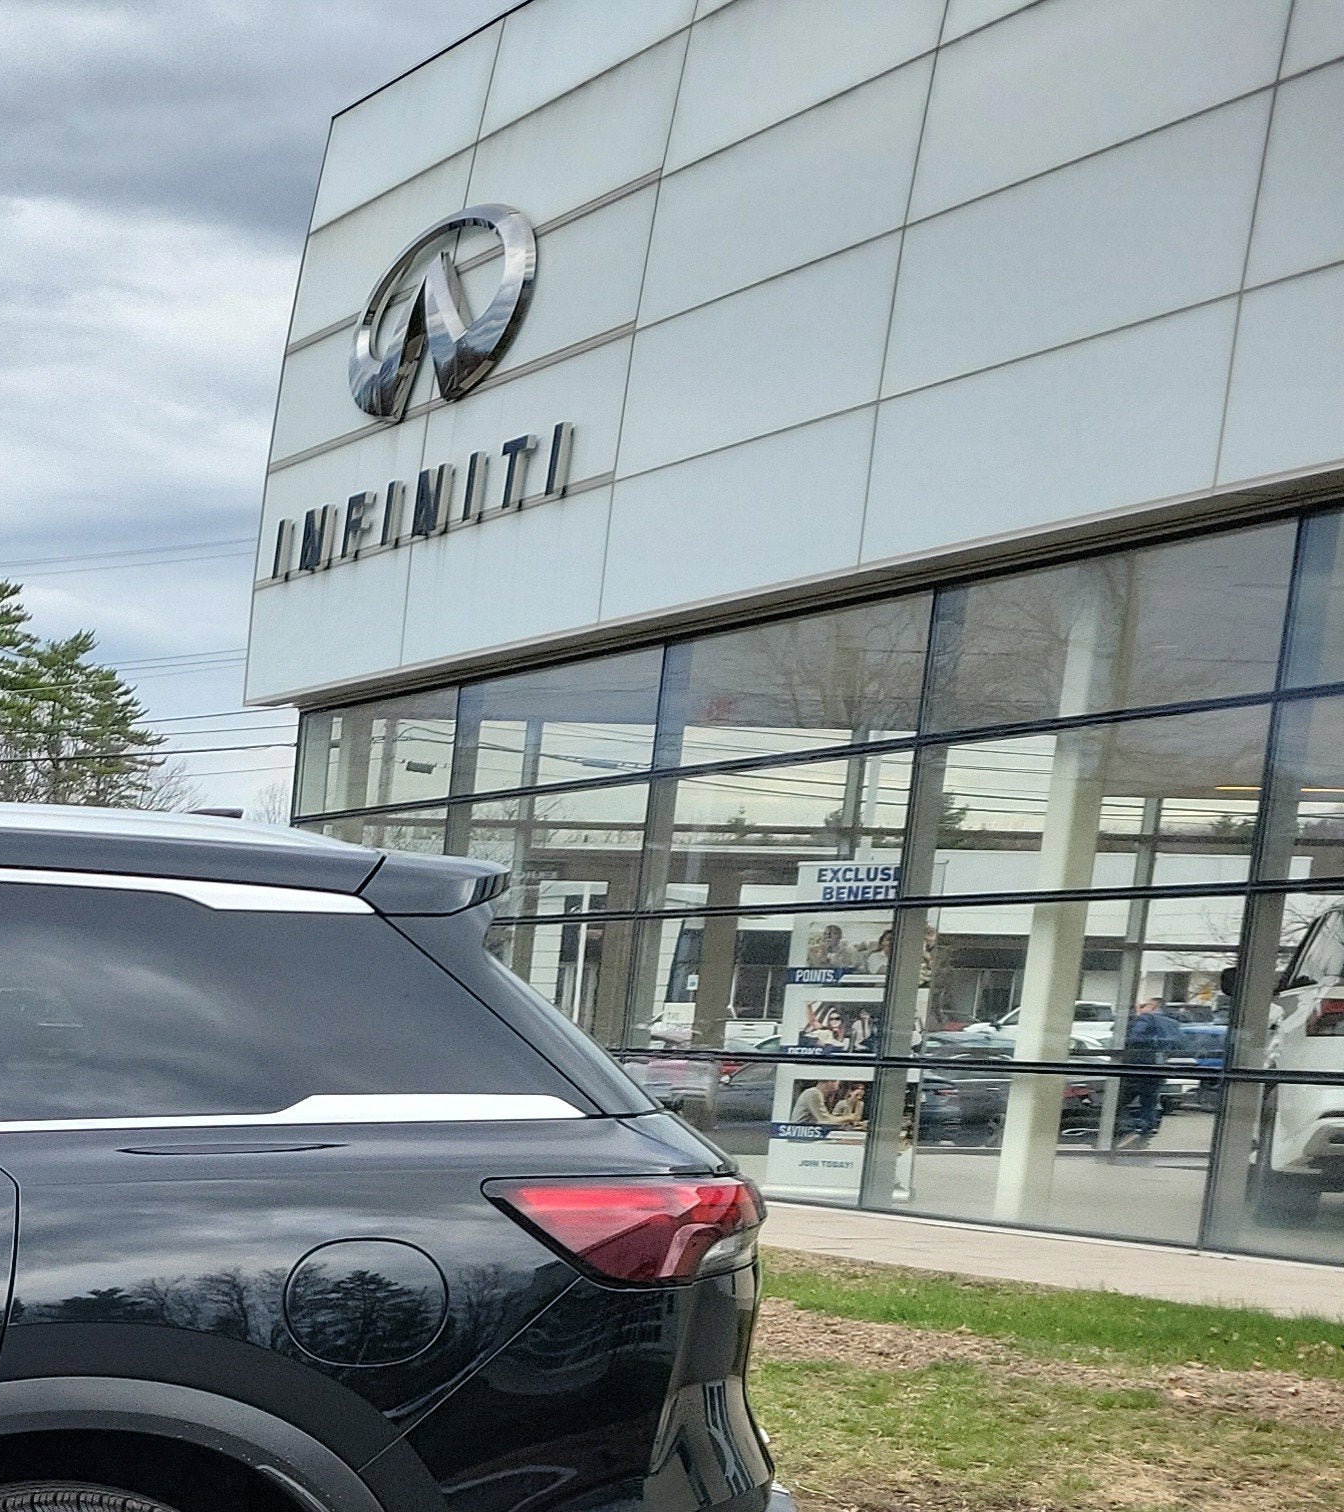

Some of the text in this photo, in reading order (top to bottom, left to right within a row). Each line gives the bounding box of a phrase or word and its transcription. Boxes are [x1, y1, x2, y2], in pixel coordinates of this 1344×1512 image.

[272, 421, 573, 580] INFINITI
[822, 884, 898, 900] BENEFIT
[795, 968, 837, 983] POINTS.
